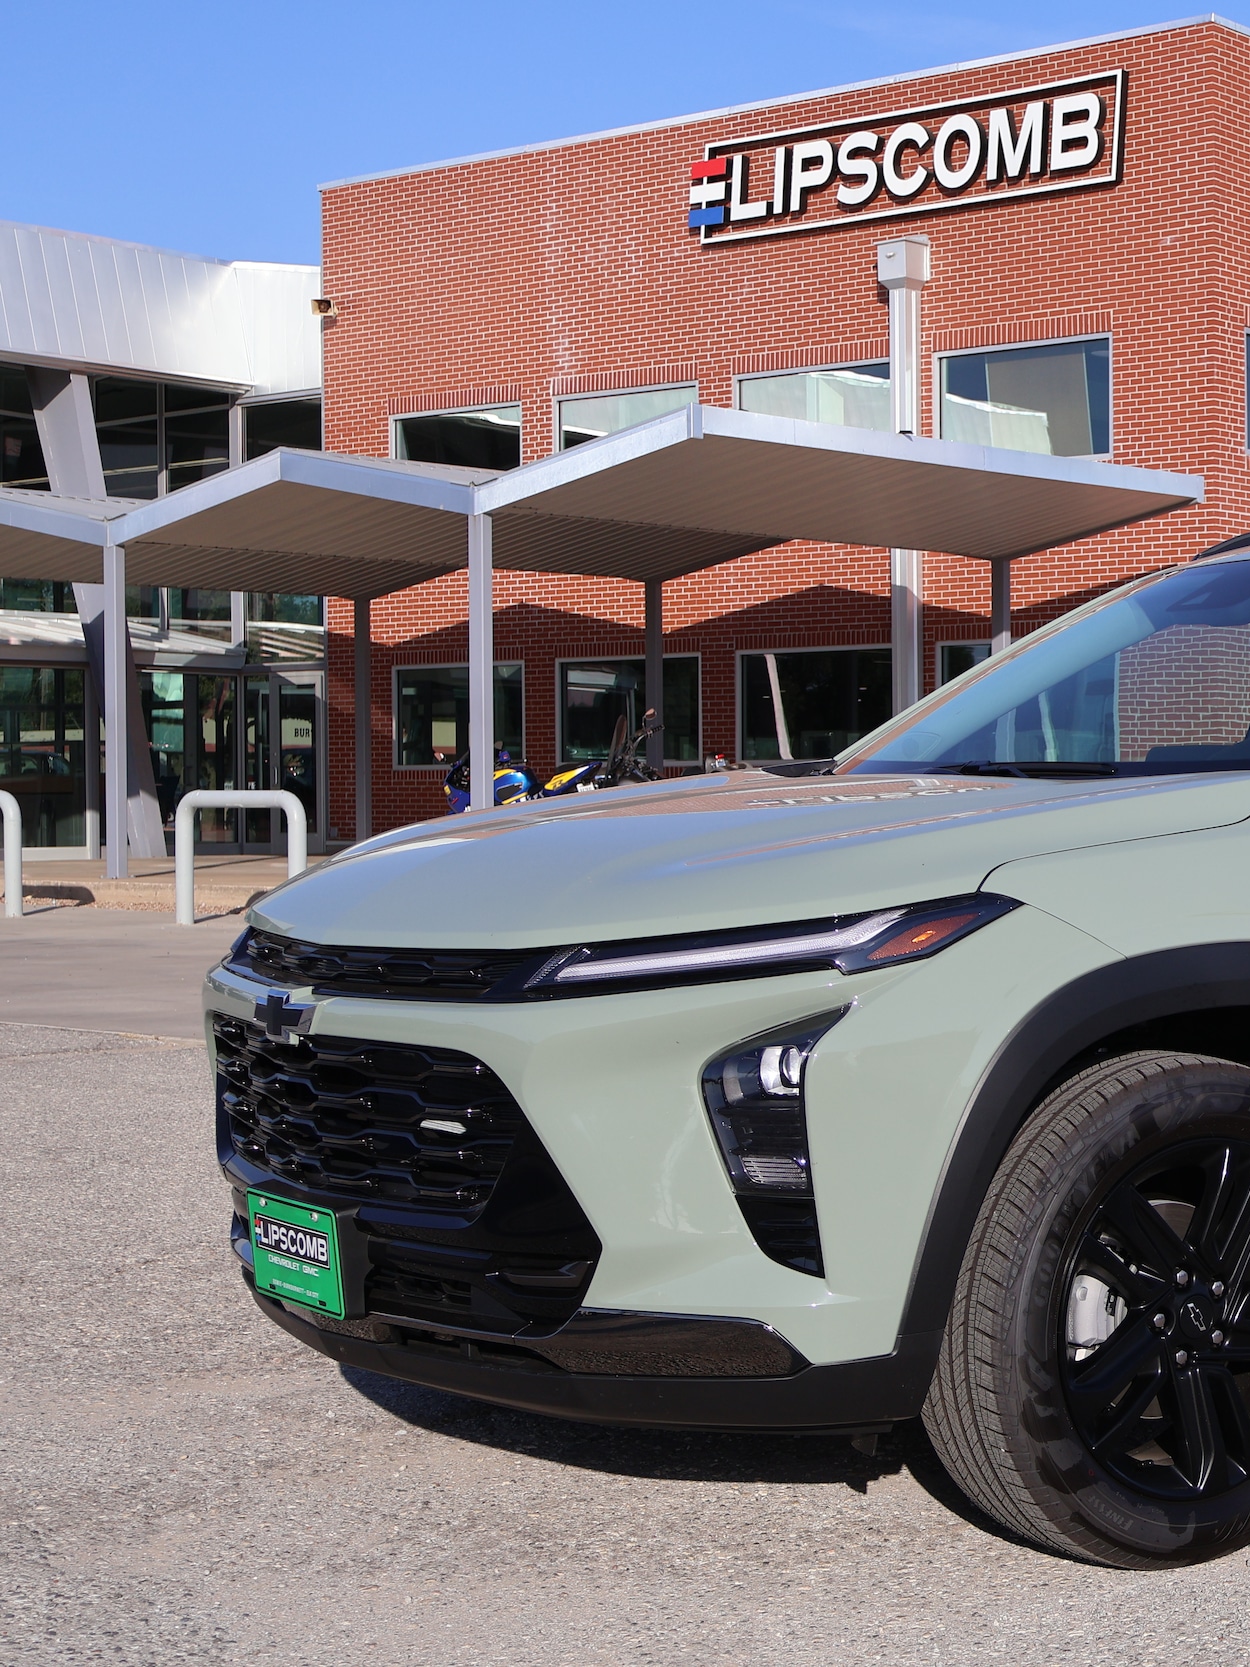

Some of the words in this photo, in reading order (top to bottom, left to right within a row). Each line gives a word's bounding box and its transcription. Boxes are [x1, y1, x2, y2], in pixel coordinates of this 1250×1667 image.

[730, 92, 1102, 222] LIPSCOMB
[294, 727, 313, 738] BUR
[260, 1220, 328, 1262] LIPSCOMB
